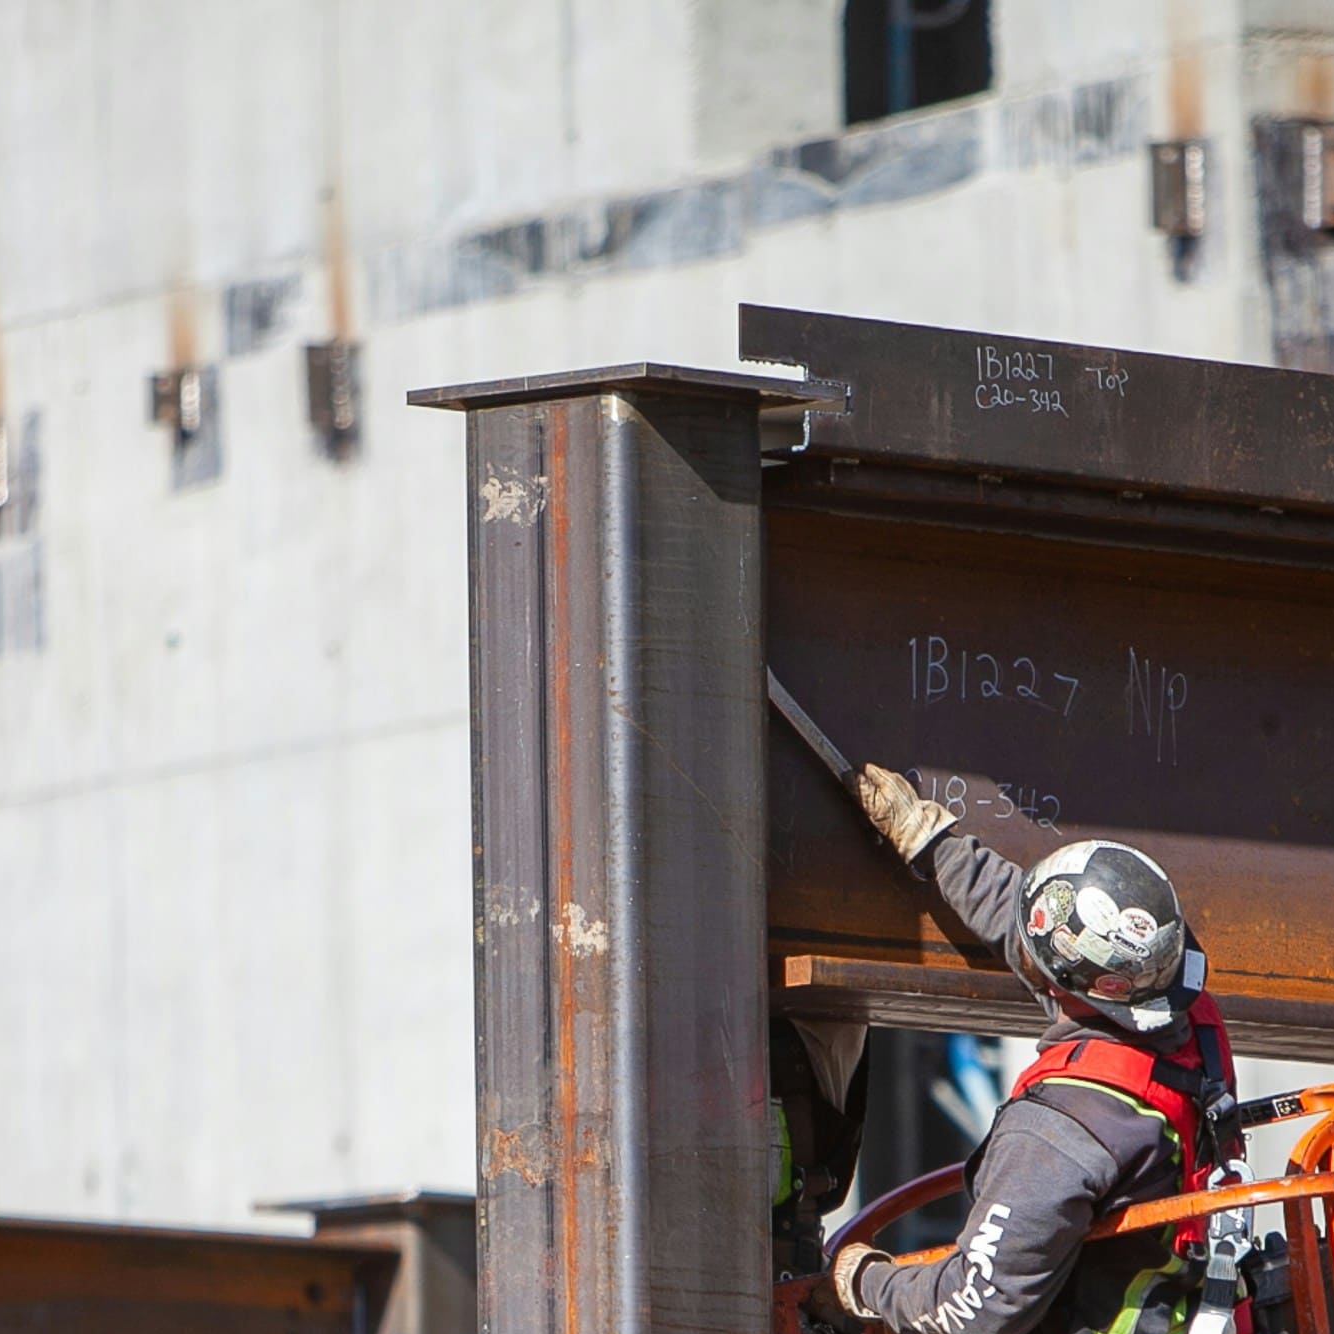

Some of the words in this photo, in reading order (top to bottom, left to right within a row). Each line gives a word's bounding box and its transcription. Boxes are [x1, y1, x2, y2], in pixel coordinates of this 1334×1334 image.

[976, 345, 1054, 382] 1B1227
[974, 383, 1070, 419] C20-342
[908, 635, 1079, 718] 1B1227
